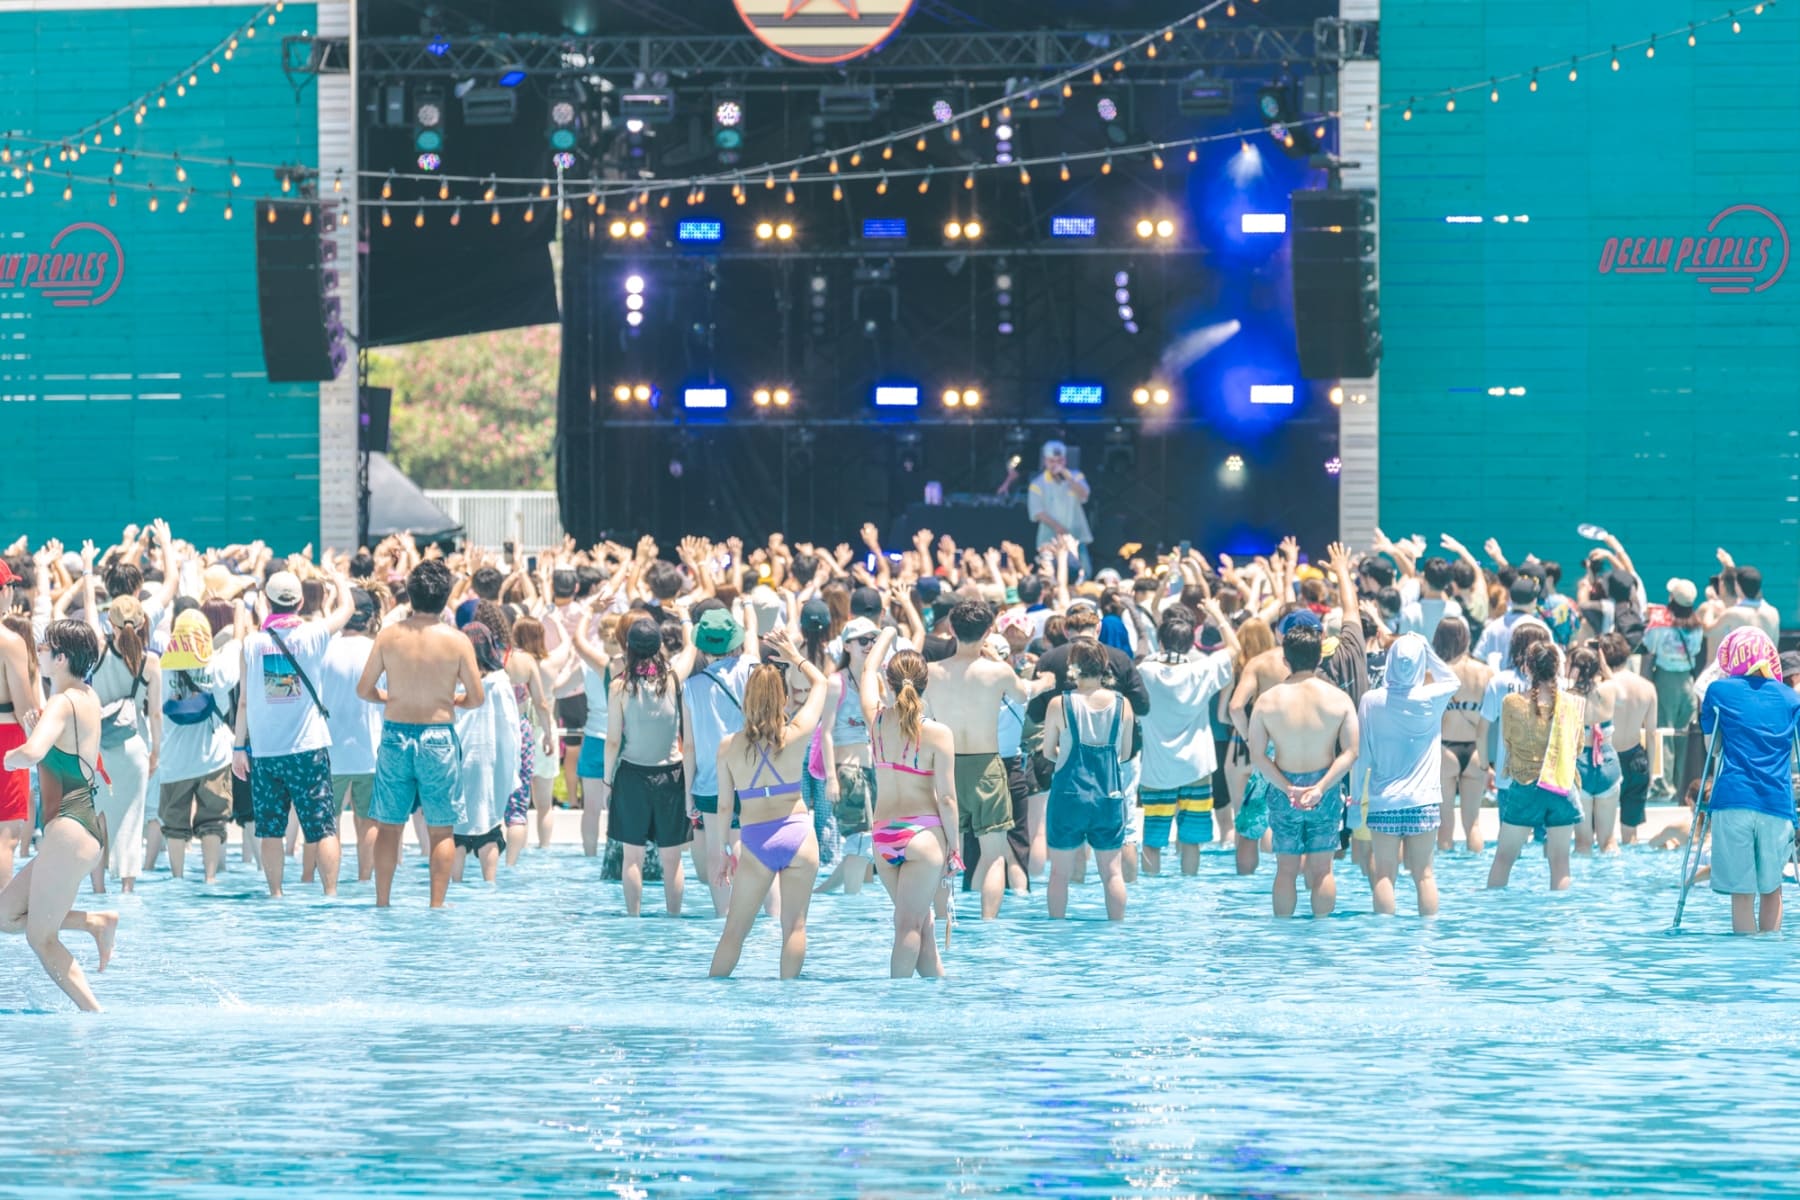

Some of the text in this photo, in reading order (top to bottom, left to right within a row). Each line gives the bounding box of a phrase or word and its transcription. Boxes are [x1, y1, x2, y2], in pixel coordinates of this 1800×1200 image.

[20, 253, 109, 288] PEOPLES
[1598, 237, 1772, 273] OCEAN PEOPLES
